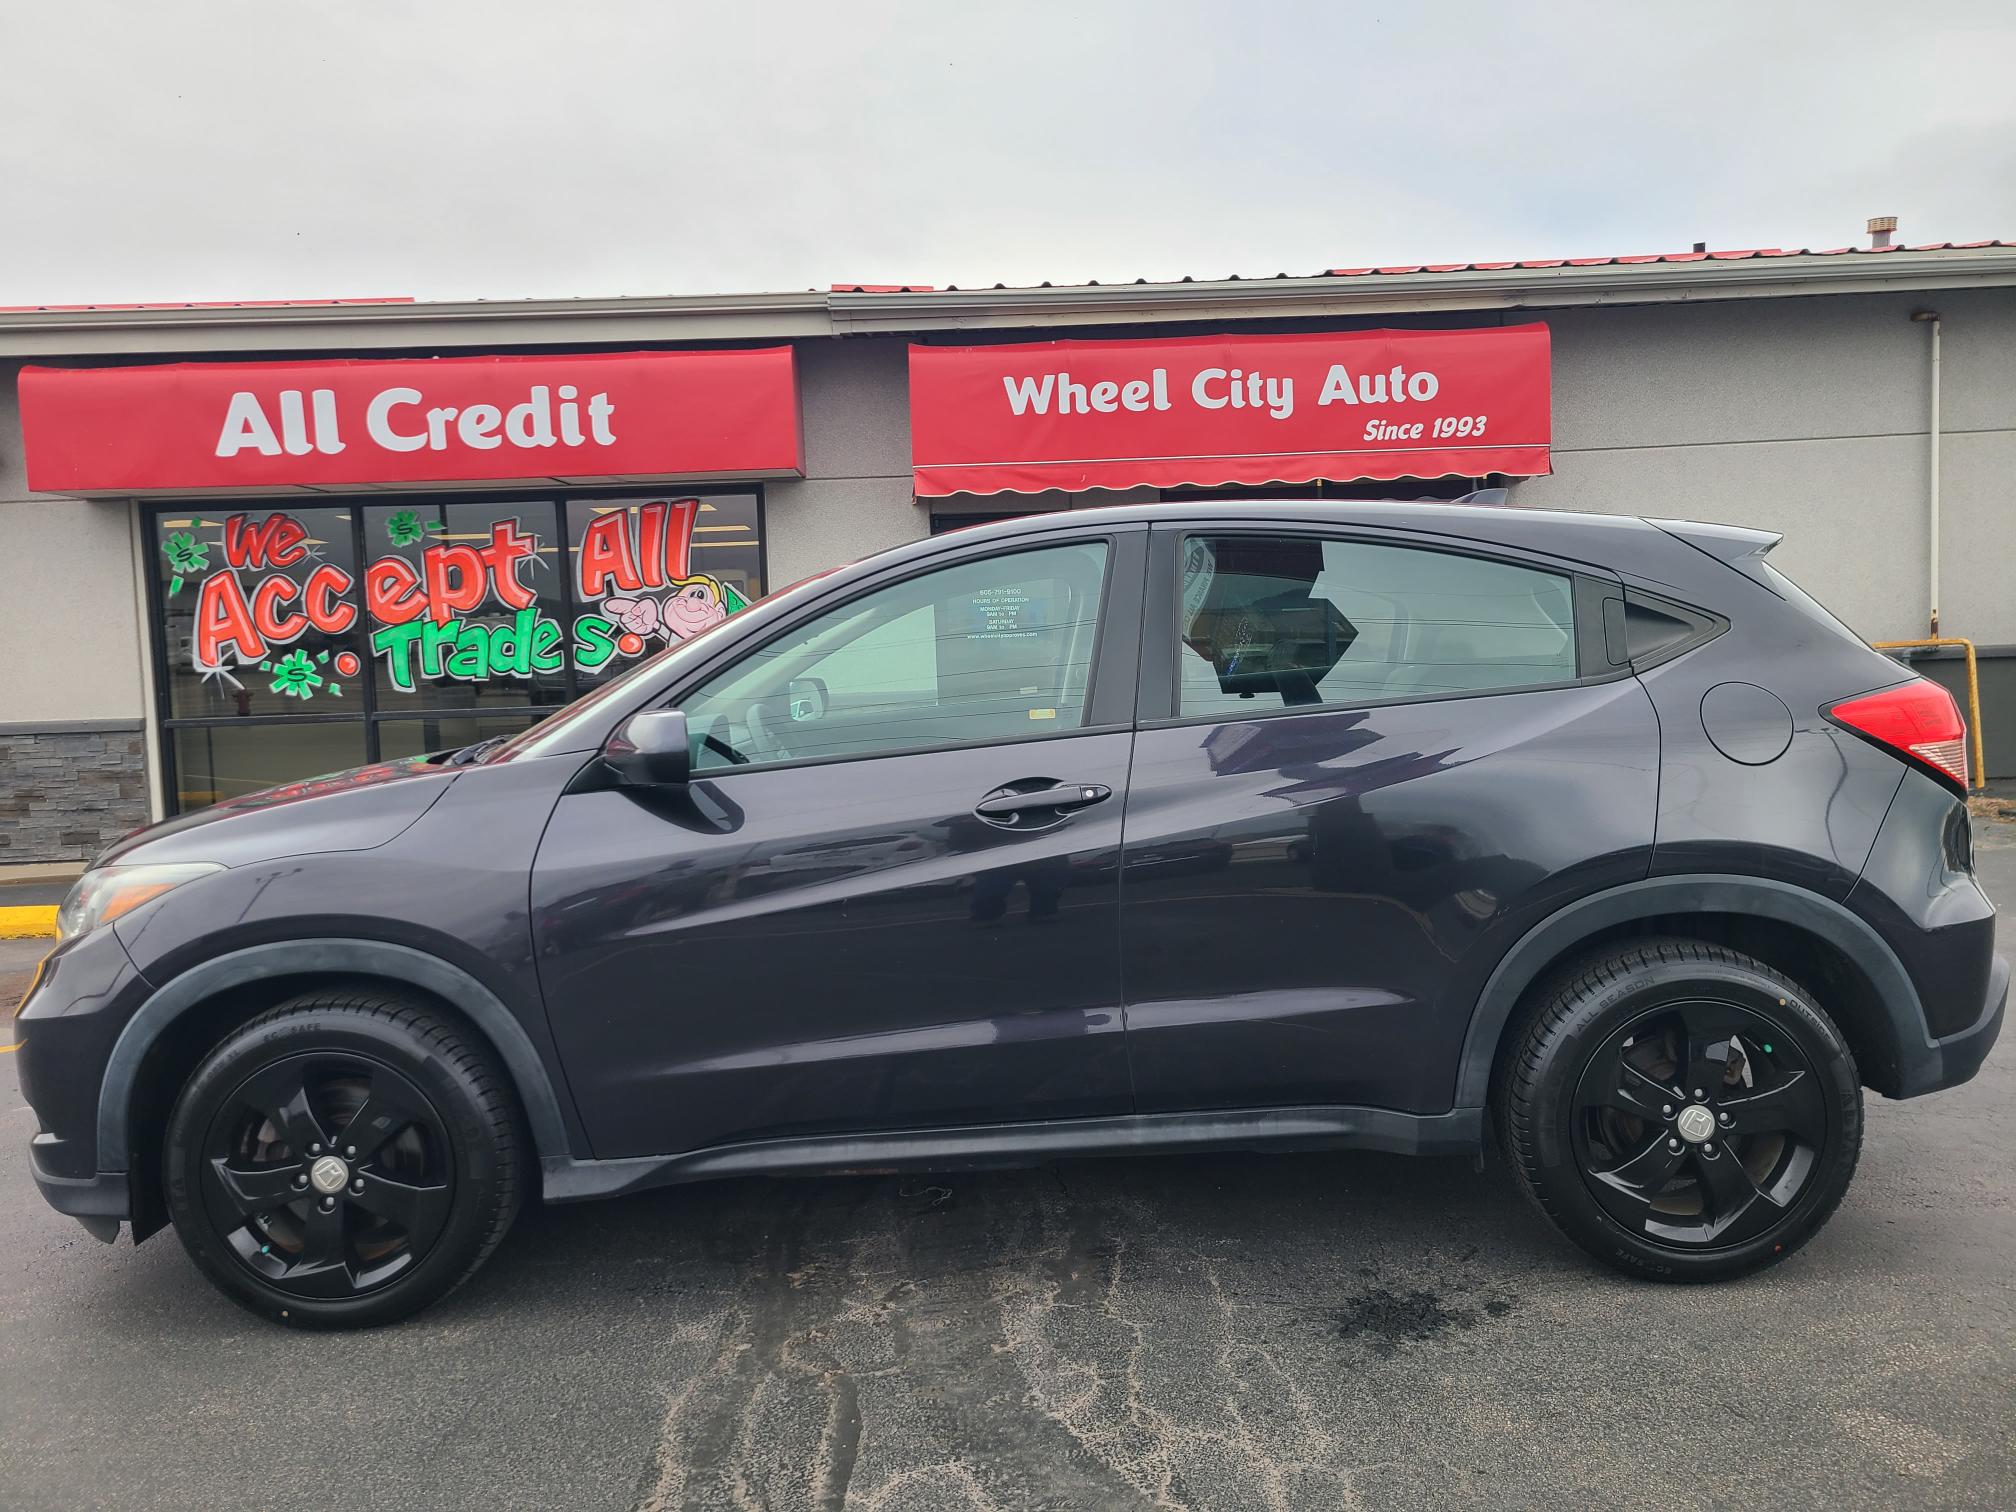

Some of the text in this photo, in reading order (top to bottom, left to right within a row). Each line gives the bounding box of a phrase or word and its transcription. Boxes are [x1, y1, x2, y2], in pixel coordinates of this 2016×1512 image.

[216, 386, 616, 456] All Credit
[1004, 365, 1438, 419] Wheel City Auto
[1364, 416, 1486, 440] Since 1993
[225, 513, 309, 568] We
[194, 499, 700, 671] Accept All
[374, 608, 616, 688] Trades
